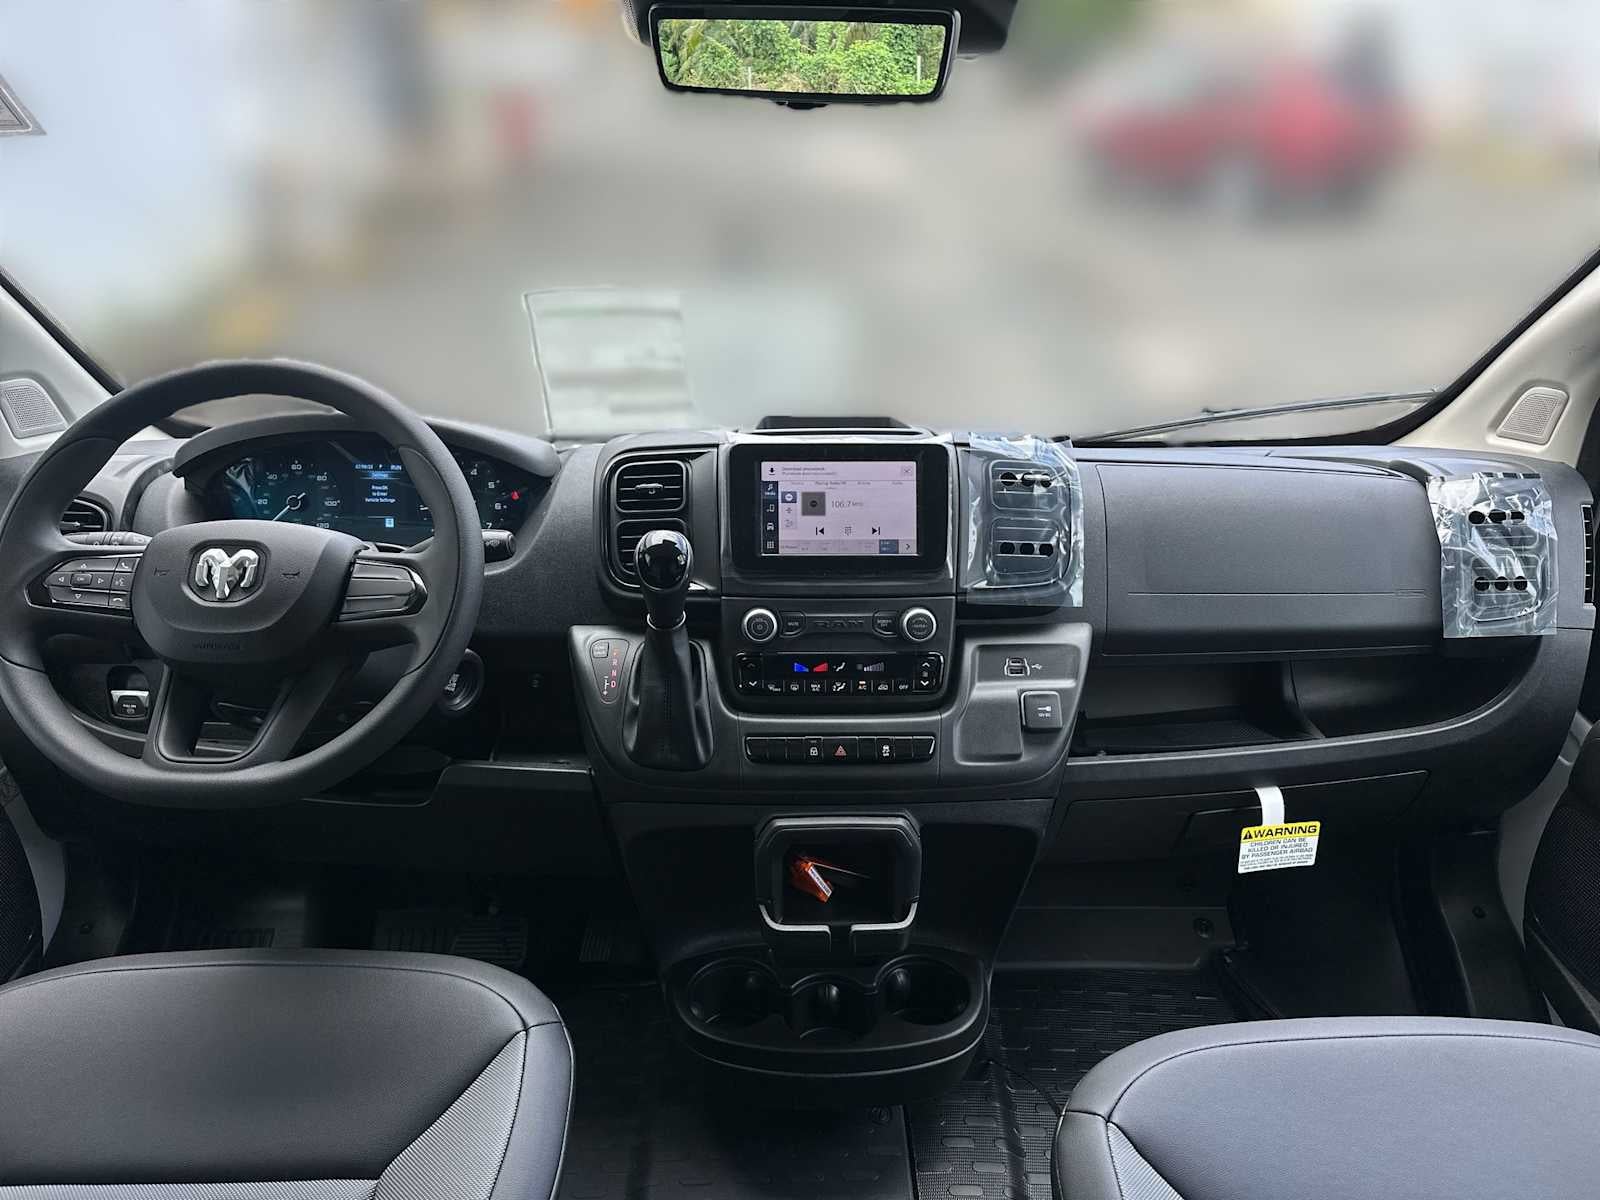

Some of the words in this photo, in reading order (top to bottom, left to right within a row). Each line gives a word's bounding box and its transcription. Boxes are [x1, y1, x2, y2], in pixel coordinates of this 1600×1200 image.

[487, 481, 495, 489] 5
[831, 500, 851, 509] 106.7
[1253, 825, 1318, 839] WARNING
[1250, 839, 1281, 848] CHILDREN
[1280, 842, 1309, 850] INJURED
[1251, 849, 1289, 858] PASSENGER
